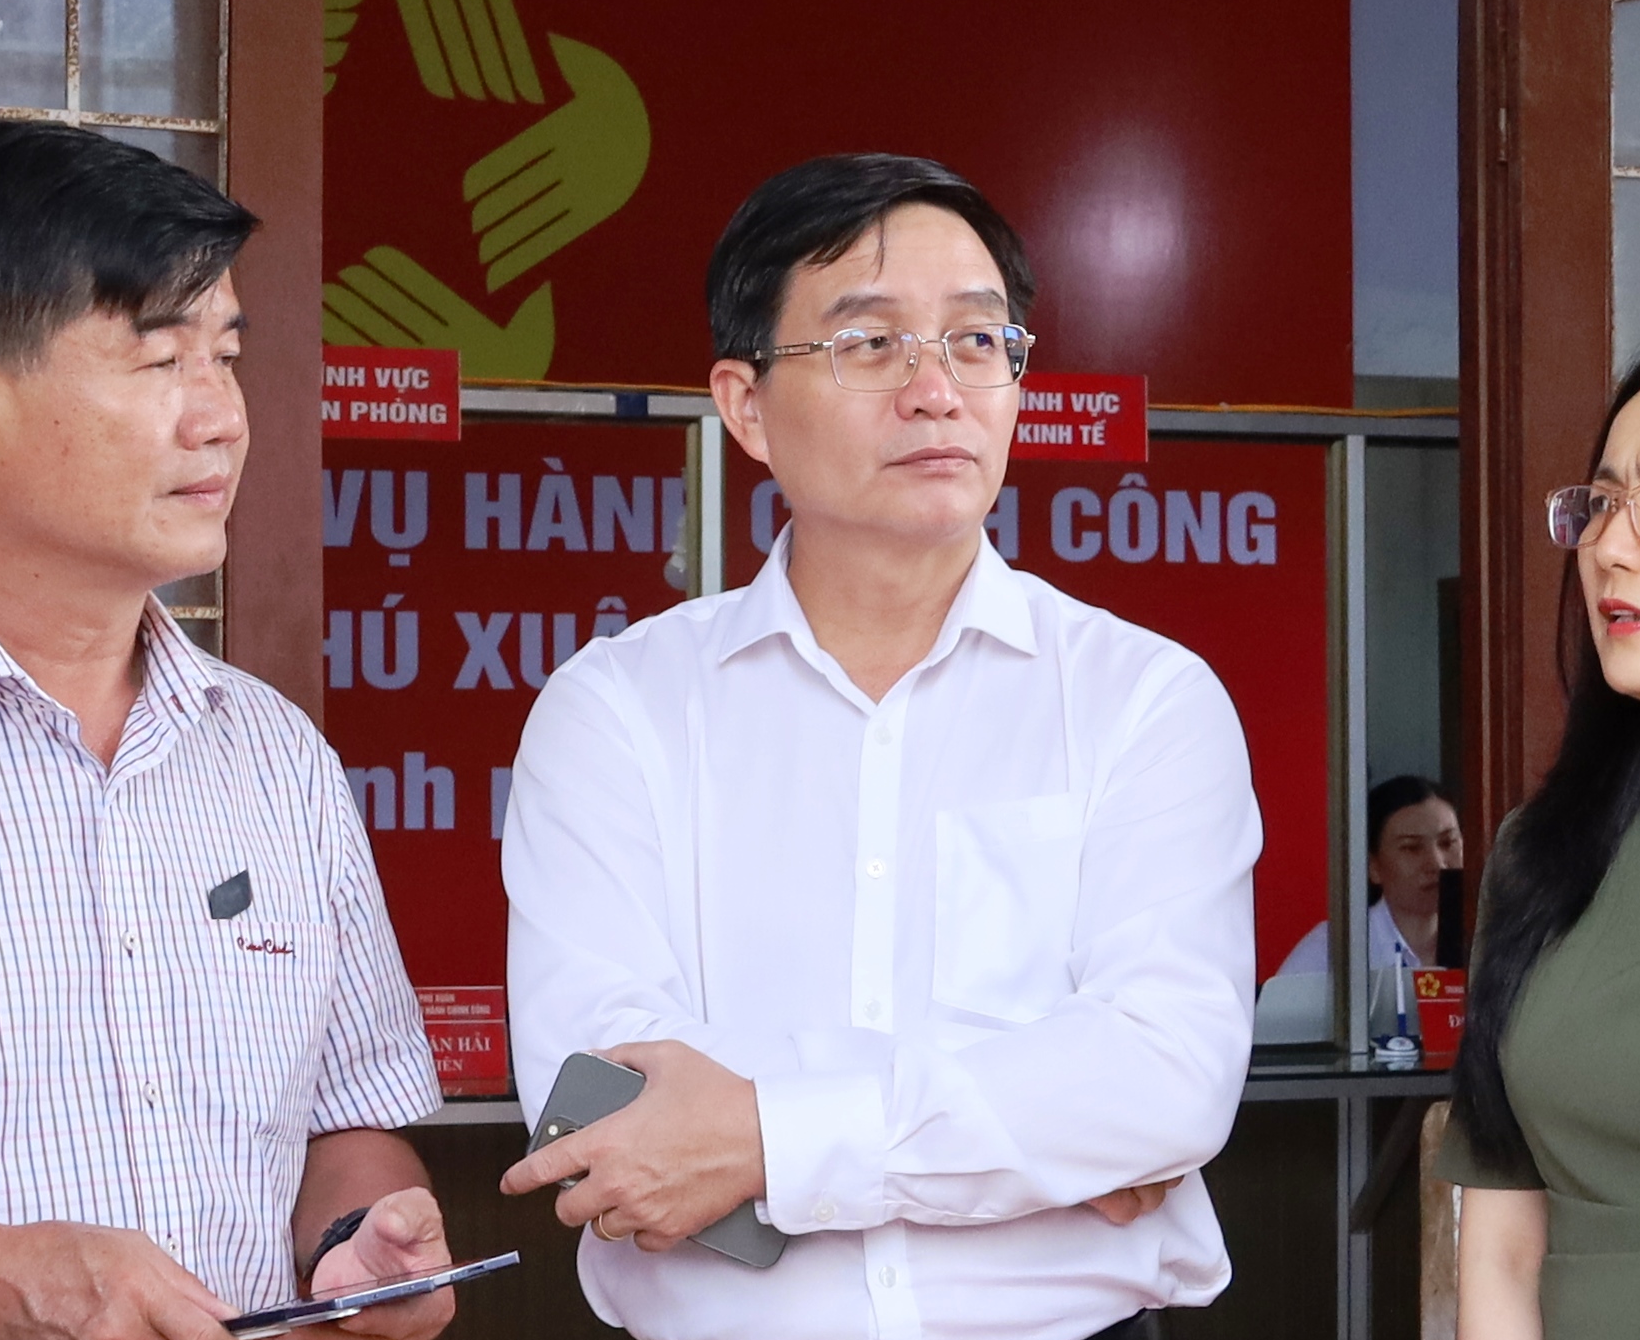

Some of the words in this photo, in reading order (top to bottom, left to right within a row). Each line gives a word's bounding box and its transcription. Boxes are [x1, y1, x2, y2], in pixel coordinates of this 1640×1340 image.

[374, 366, 430, 394] VỰC
[350, 397, 448, 425] PHÒNG
[1070, 391, 1121, 417] VỰC
[1017, 422, 1073, 445] KINH
[1079, 419, 1107, 446] TẾ
[323, 469, 429, 567] VỤ
[1051, 471, 1277, 565] CÔNG
[458, 1031, 491, 1052] HẢI
